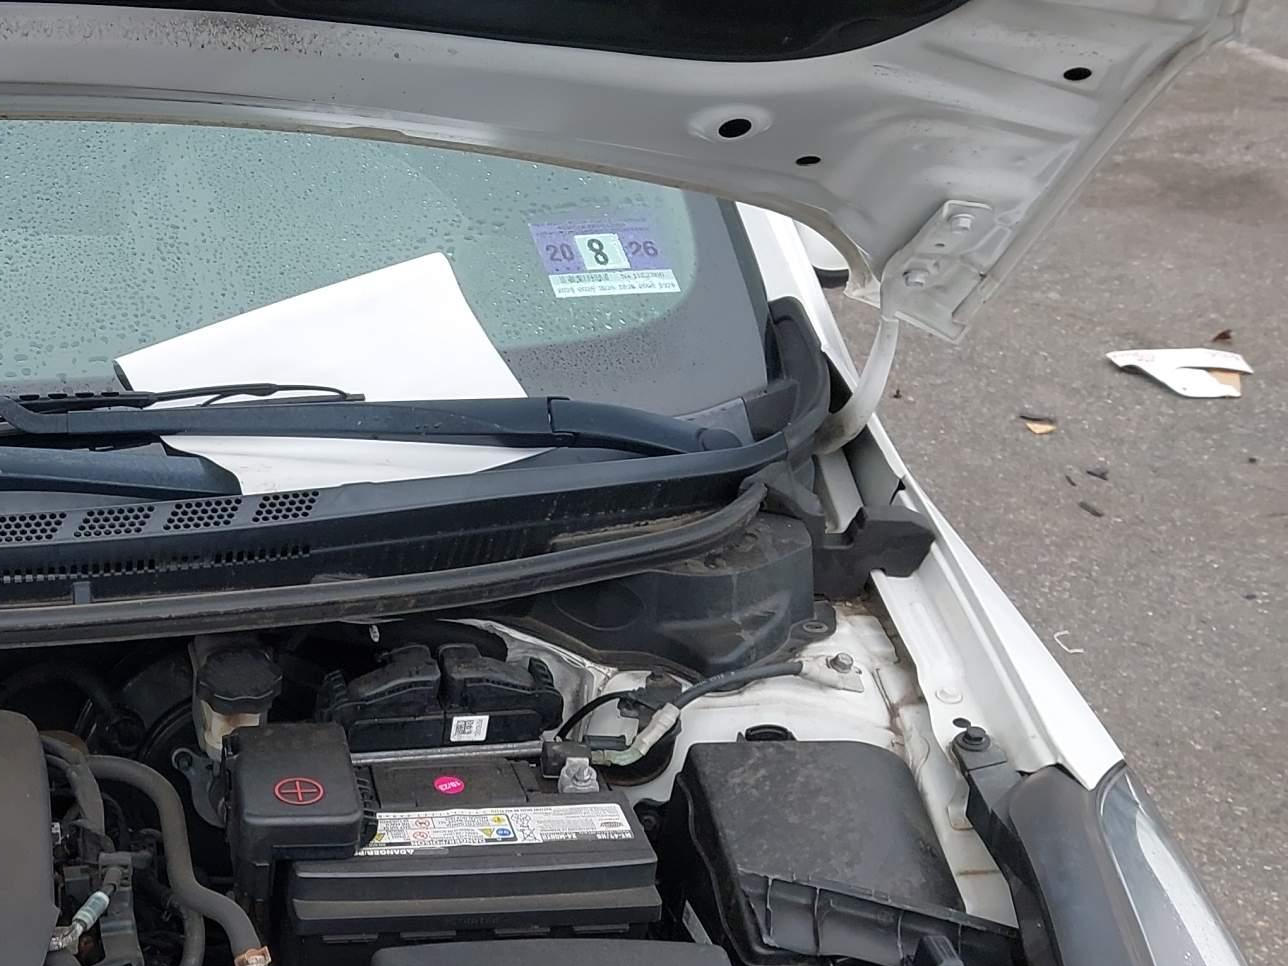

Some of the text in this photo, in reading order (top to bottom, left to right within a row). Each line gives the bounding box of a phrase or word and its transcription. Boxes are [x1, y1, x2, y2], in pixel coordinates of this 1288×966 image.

[545, 238, 659, 266] 20 8 26
